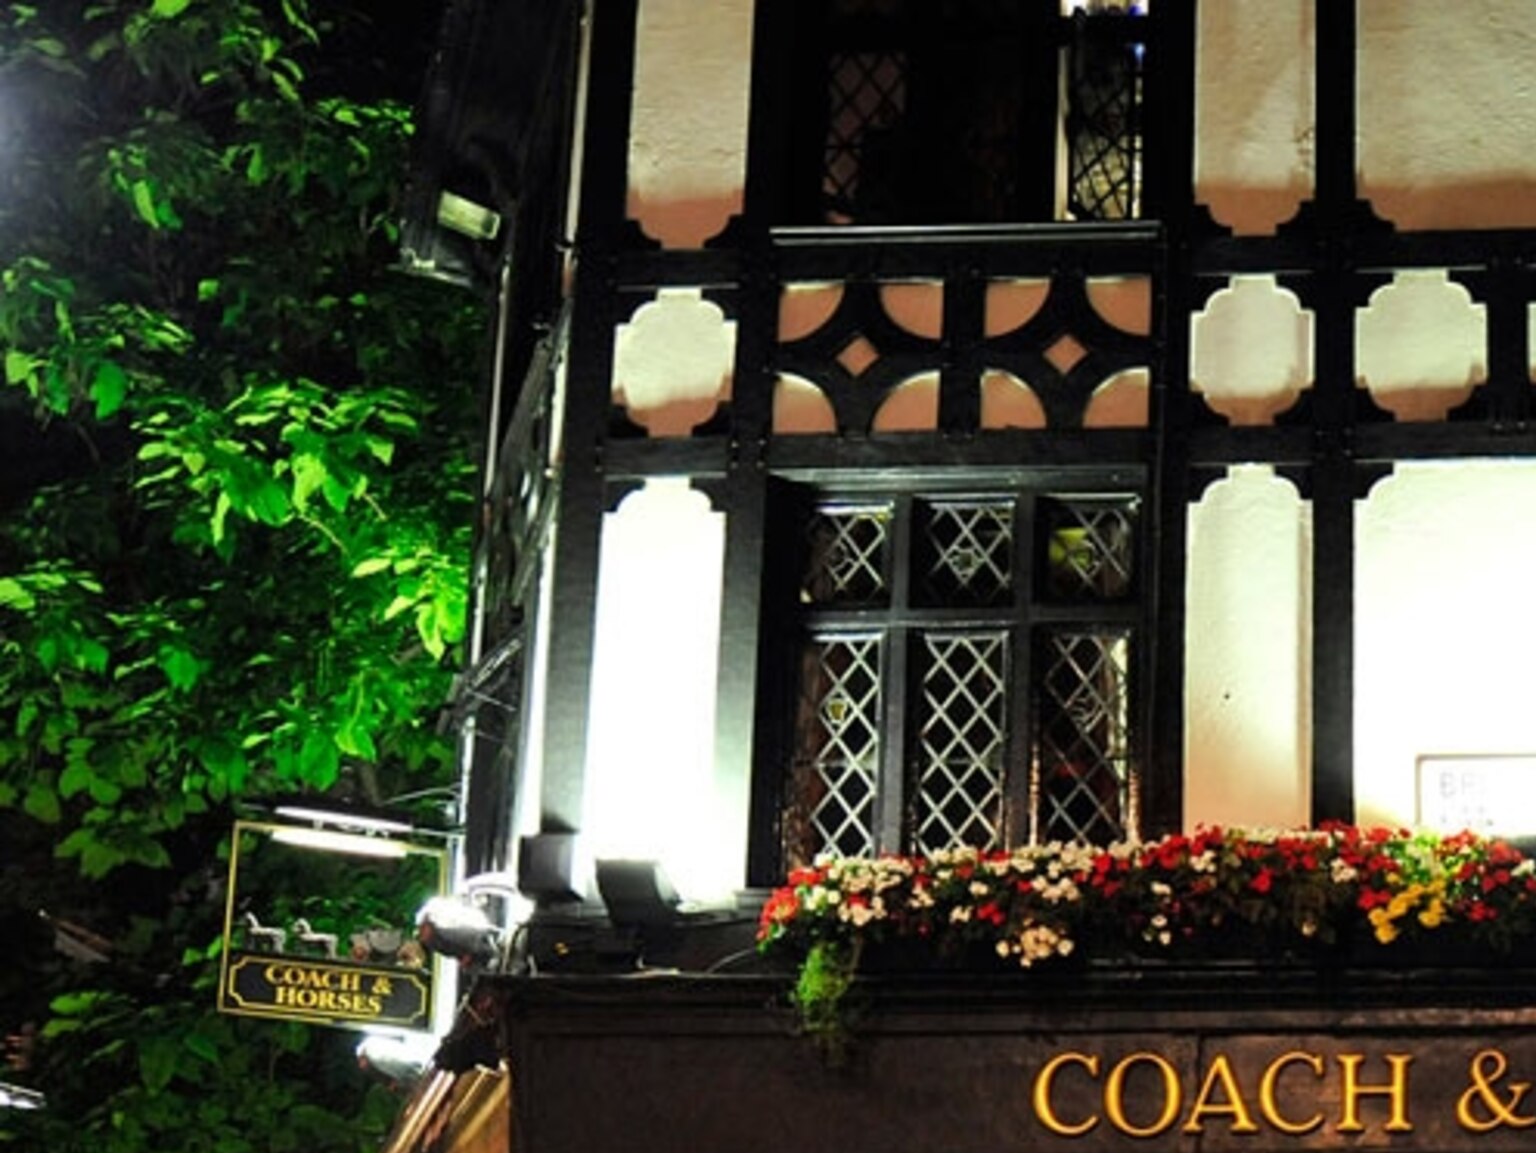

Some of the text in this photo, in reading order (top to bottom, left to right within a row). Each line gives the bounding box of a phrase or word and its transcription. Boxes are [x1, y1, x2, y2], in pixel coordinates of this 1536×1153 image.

[265, 964, 392, 995] COACH &
[275, 986, 382, 1014] HORSES
[1033, 1051, 1413, 1137] COACH
